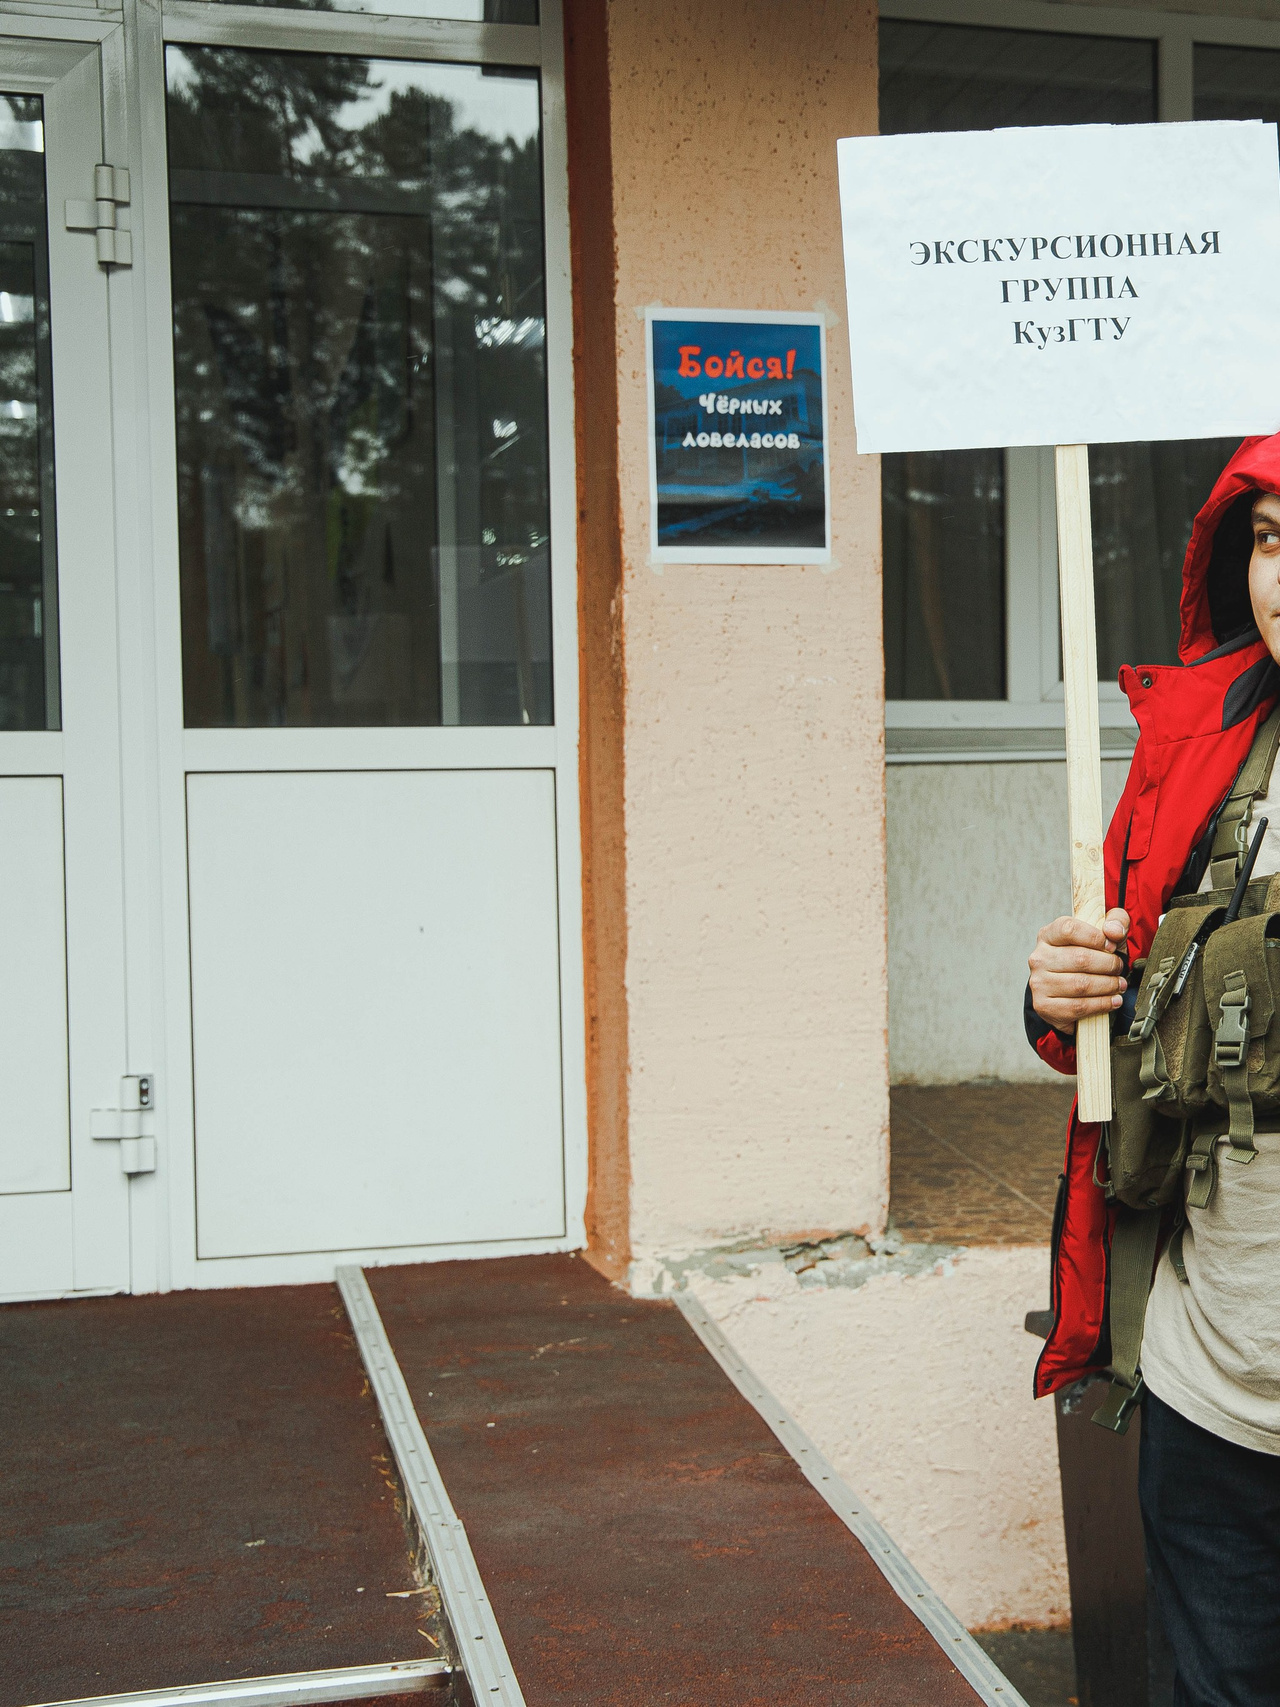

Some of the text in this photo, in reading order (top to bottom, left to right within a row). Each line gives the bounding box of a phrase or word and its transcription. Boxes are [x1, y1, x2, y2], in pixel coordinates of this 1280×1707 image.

[909, 230, 1221, 266] ЭКСКУРСИОННАЯ
[999, 275, 1140, 304] ГРУППА
[1012, 316, 1132, 350] КузГТУ
[677, 345, 797, 380] Бойся!
[699, 392, 783, 415] Чёрных
